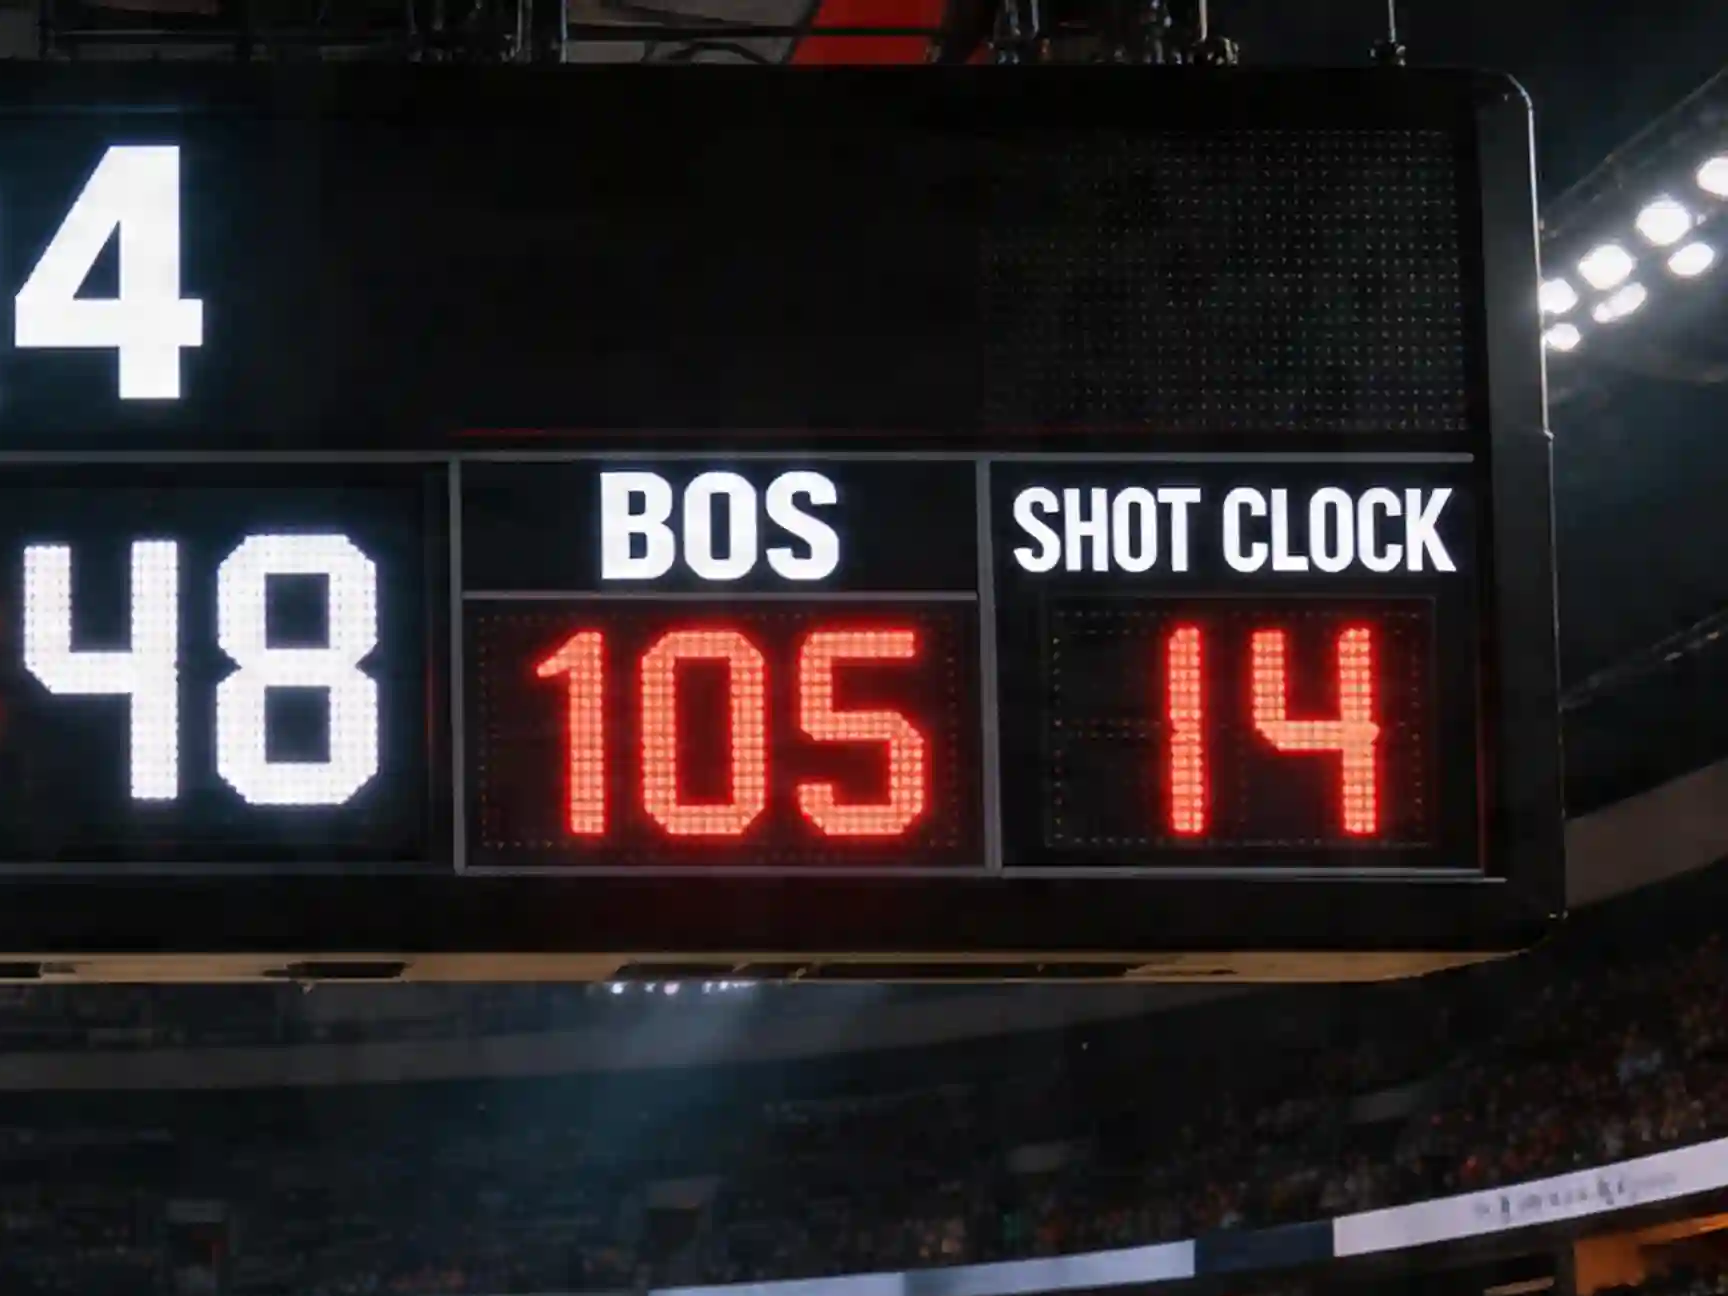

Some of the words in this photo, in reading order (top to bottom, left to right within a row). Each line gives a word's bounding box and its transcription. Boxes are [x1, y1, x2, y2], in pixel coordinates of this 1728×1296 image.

[599, 470, 840, 581] BOS
[1013, 486, 1201, 573] SHOT
[1222, 486, 1457, 573] CLOCK
[533, 624, 932, 841] 105
[1163, 623, 1384, 837] 14
